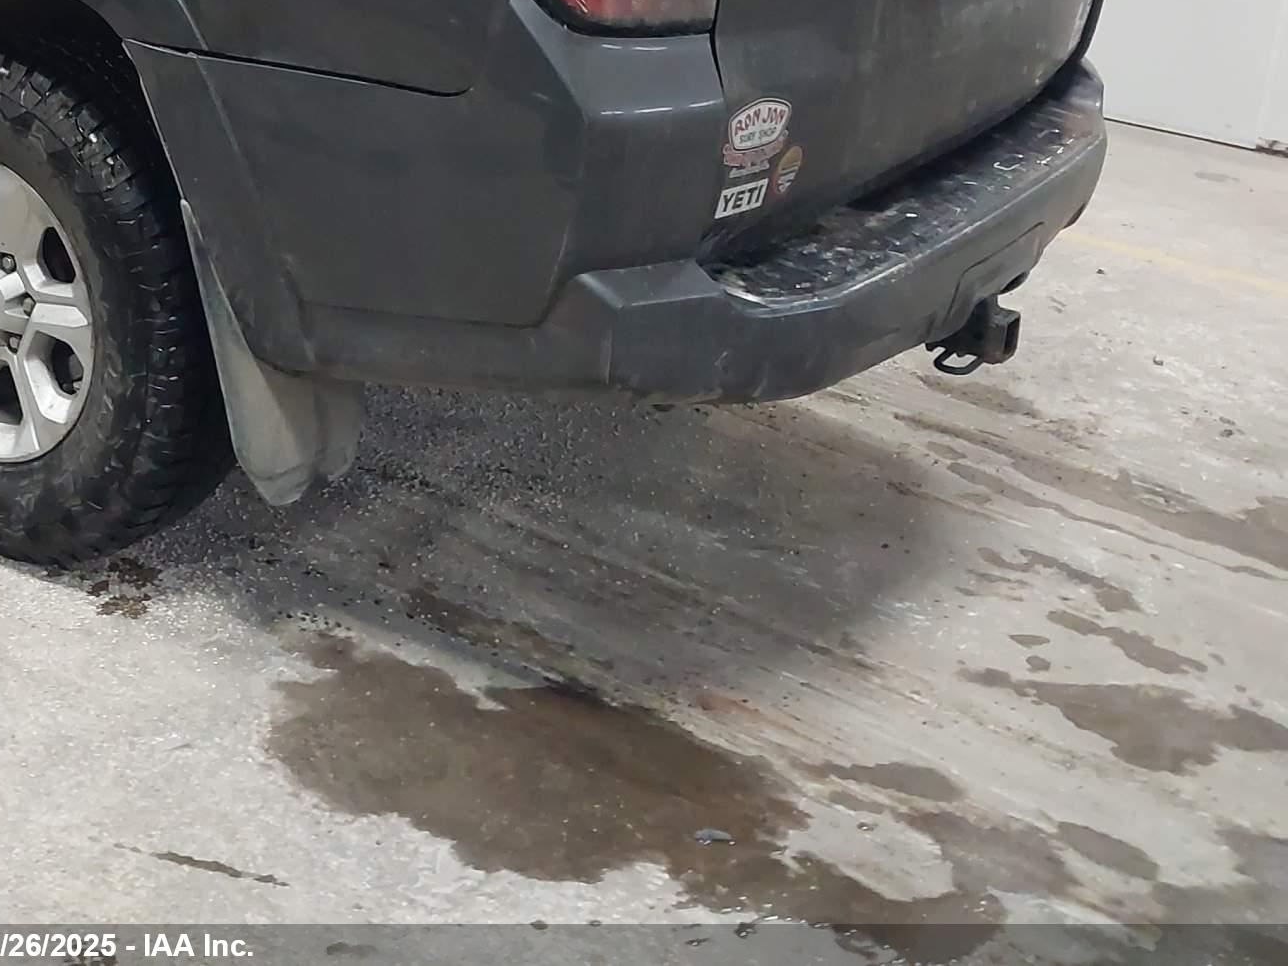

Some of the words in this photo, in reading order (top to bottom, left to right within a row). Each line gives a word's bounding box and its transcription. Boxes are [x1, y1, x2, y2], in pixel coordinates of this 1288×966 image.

[734, 108, 761, 136] RON
[762, 106, 786, 125] JON
[723, 184, 765, 213] YETI
